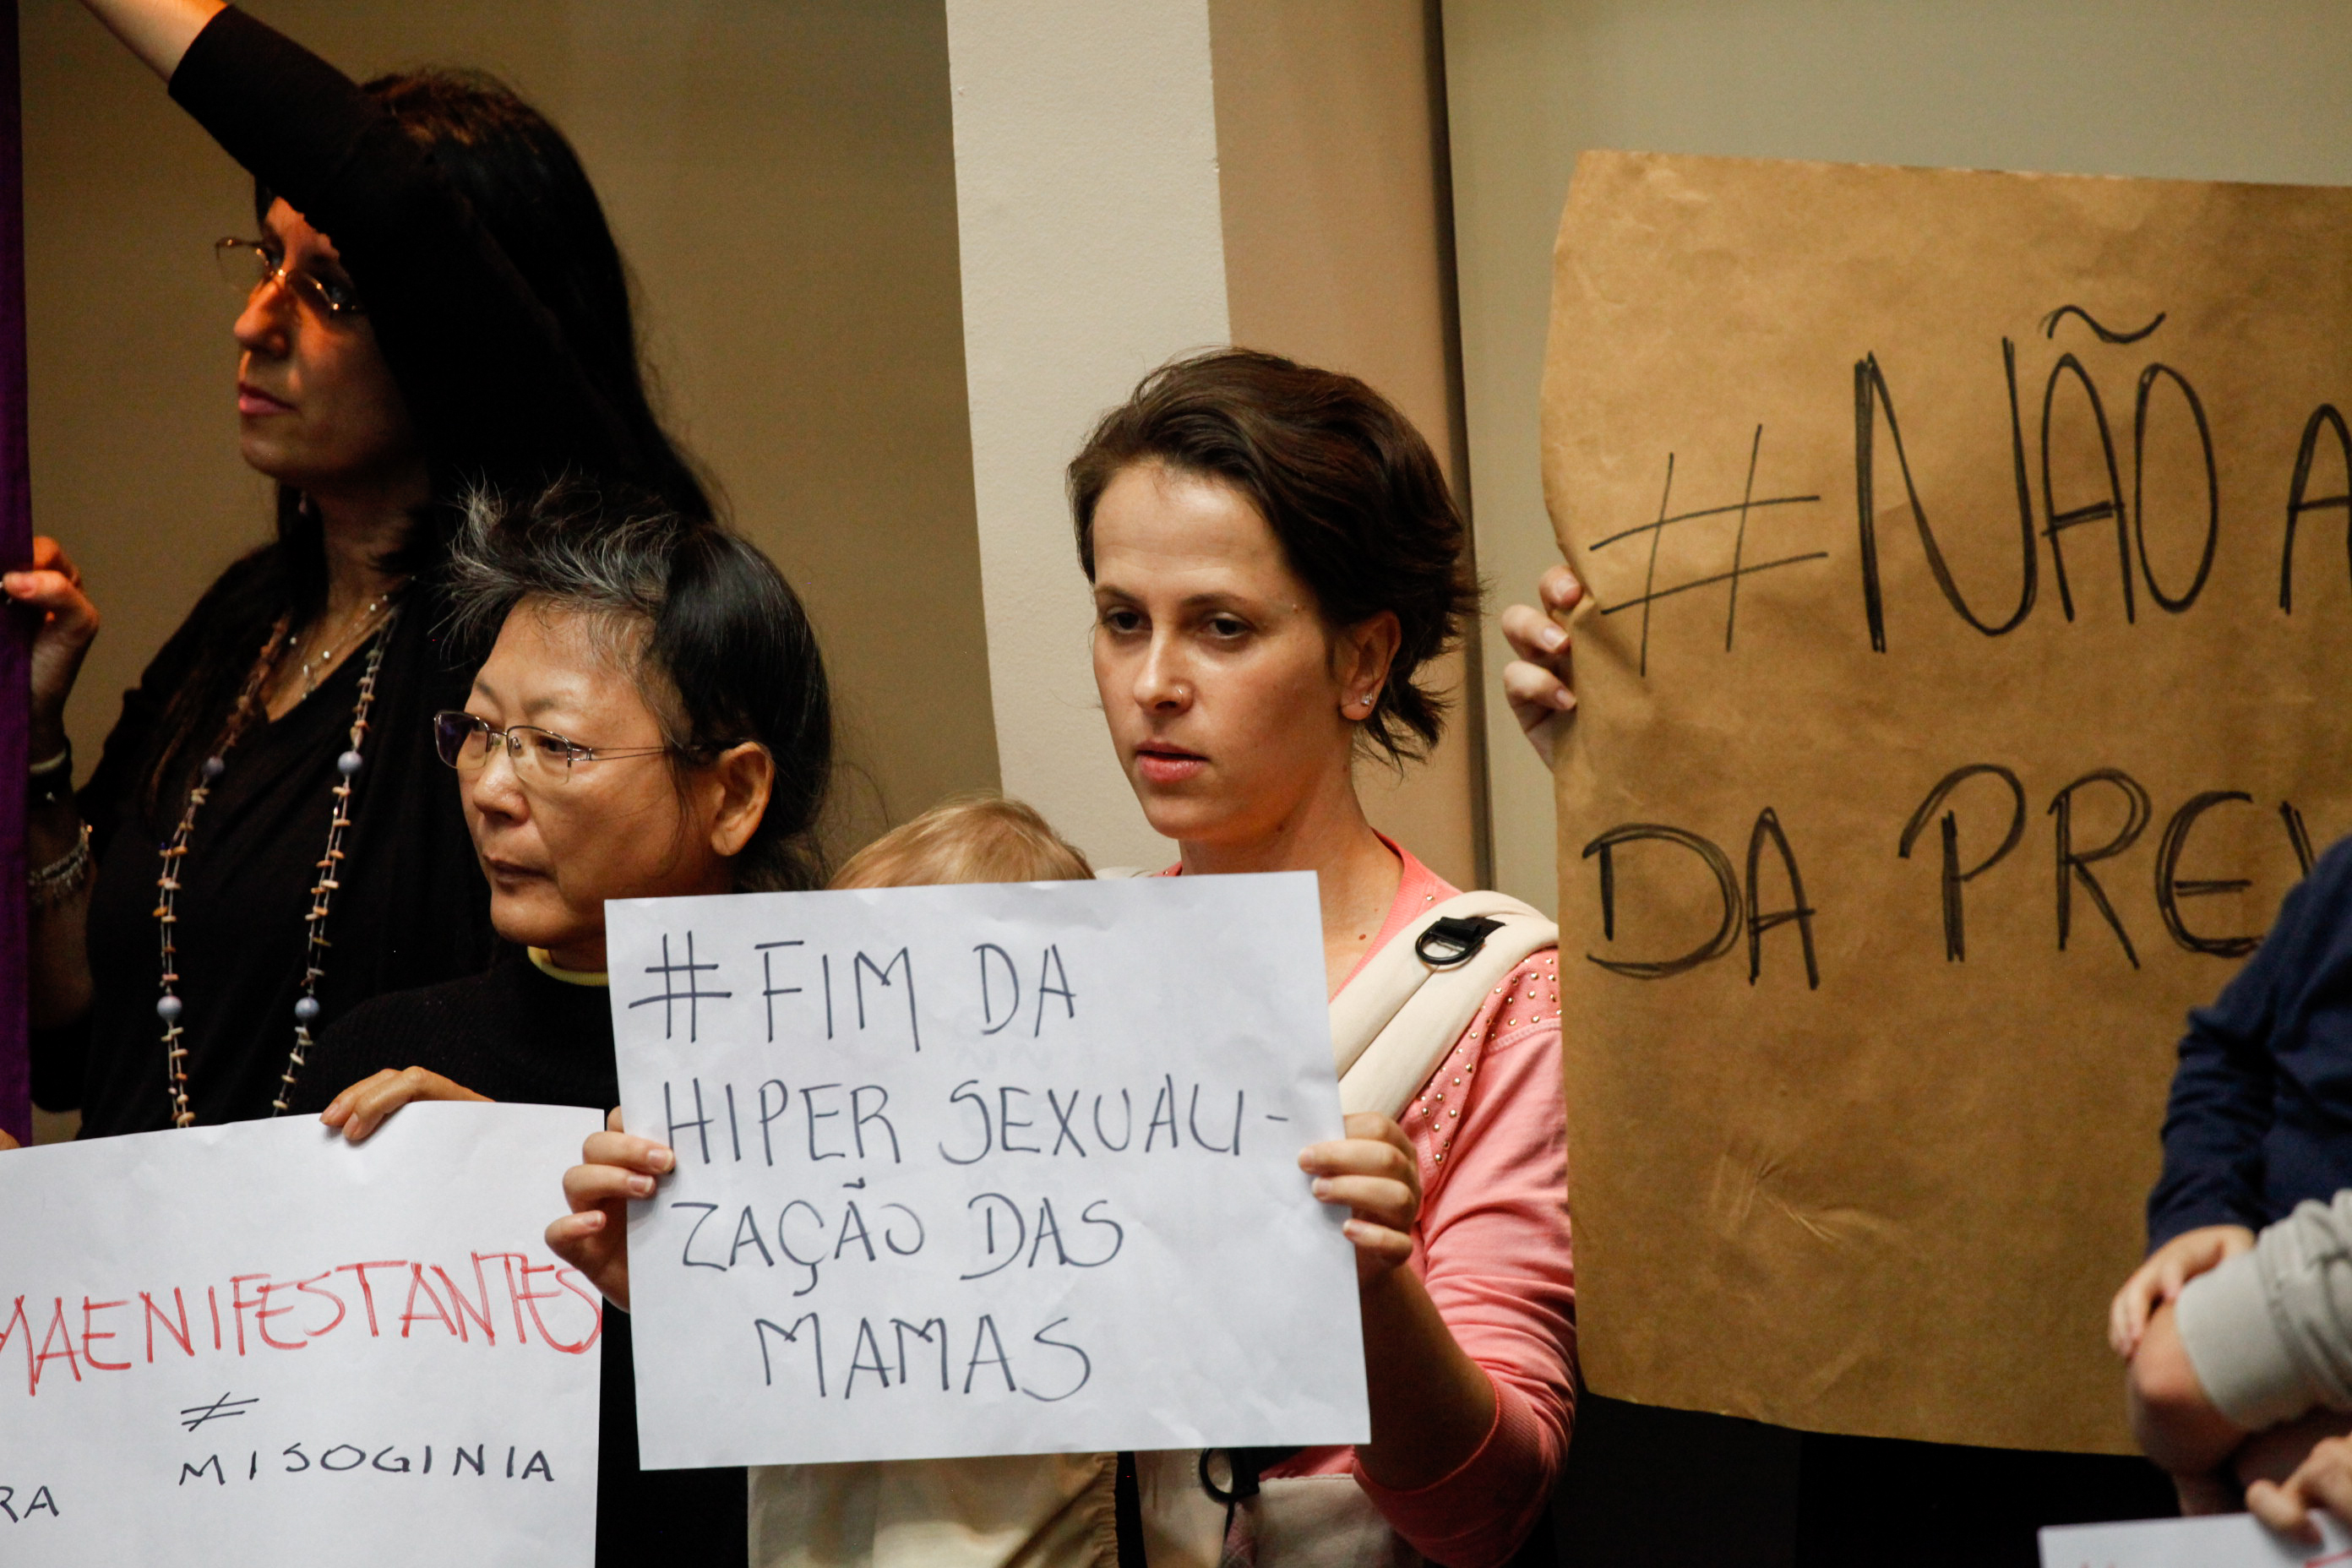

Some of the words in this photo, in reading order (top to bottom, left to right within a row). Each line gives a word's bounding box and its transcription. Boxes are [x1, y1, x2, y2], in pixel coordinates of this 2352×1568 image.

[1582, 807, 1821, 992] DA
[628, 930, 922, 1054] #FIM
[972, 942, 1077, 1038] DA
[663, 1077, 901, 1168] HIPER
[670, 1177, 926, 1298] ZAÇÃO
[958, 1192, 1124, 1282] DAS
[754, 1311, 1092, 1402] MAMAS
[179, 1441, 555, 1487] MISOGINIA
